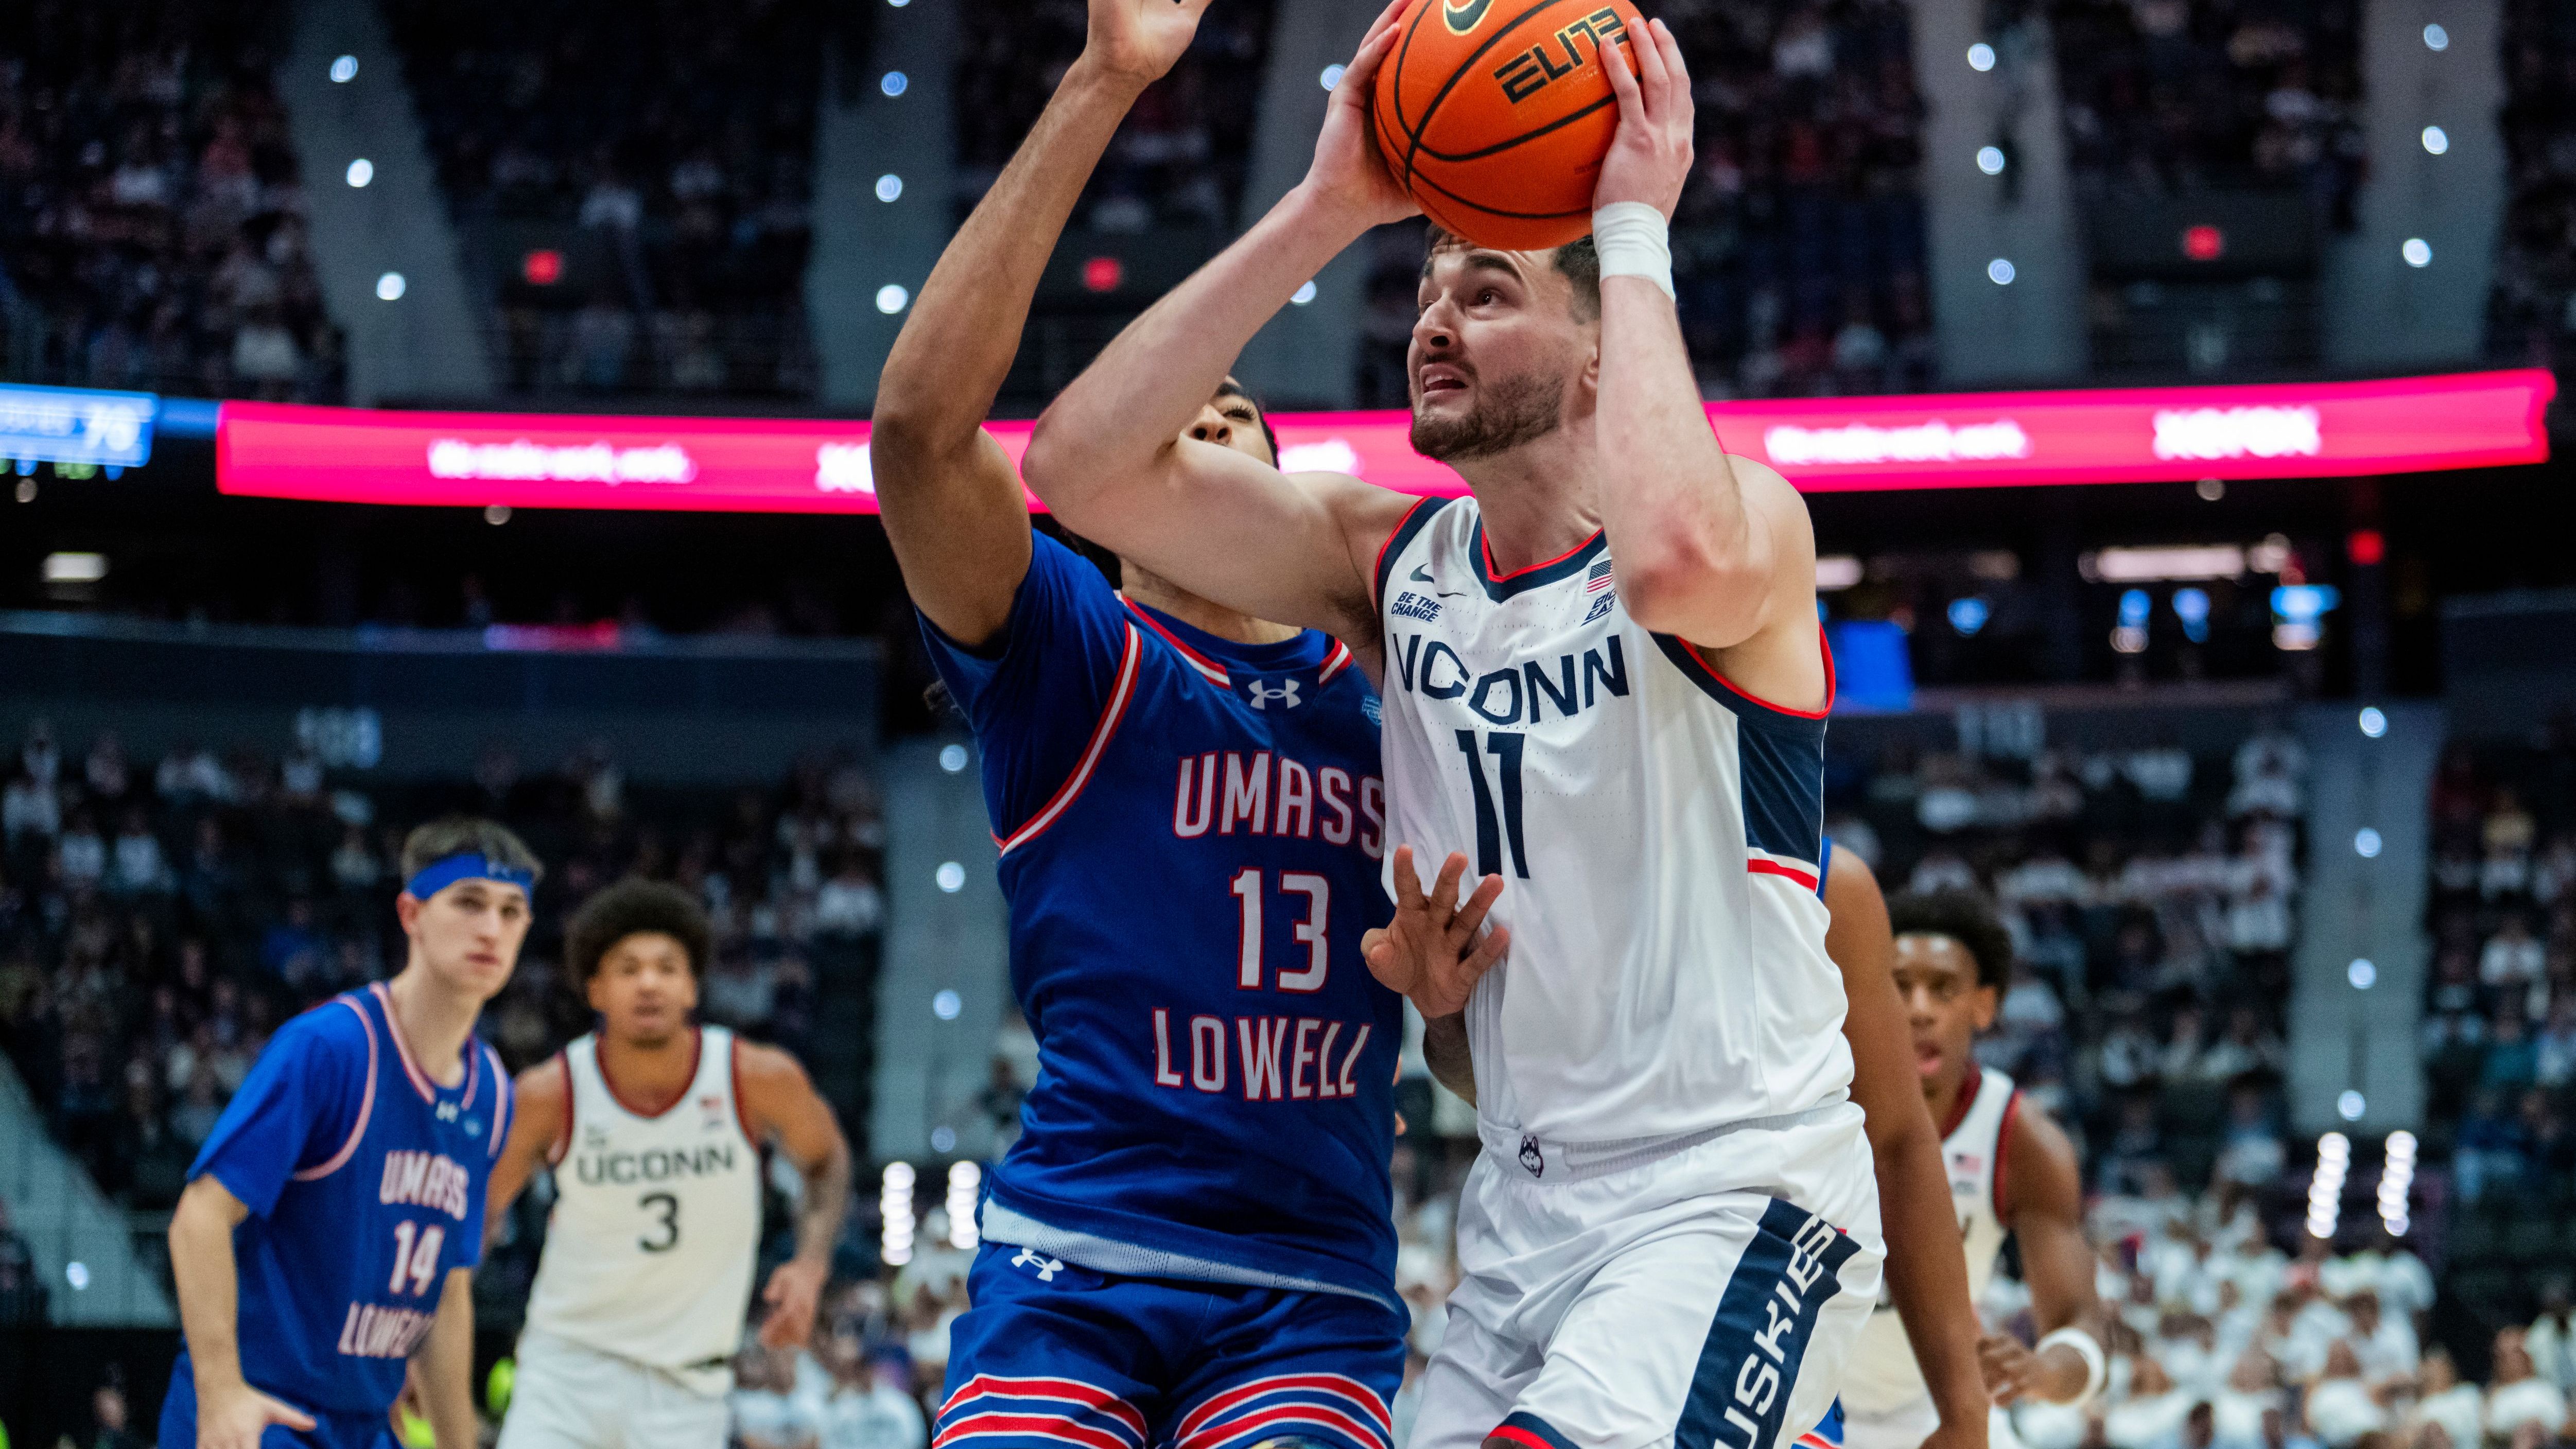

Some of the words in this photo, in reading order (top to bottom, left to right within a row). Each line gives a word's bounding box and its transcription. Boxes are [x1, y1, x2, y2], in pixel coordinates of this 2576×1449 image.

[1492, 5, 1630, 104] ELITE
[1391, 602, 1438, 622] CHANGE
[1397, 591, 1417, 603] BE
[1416, 596, 1442, 613] THE
[1585, 597, 1616, 621] EAS
[1393, 634, 1629, 725] UCONN
[1172, 750, 1386, 861] UMASS
[1455, 729, 1530, 879] 11
[1229, 866, 1330, 993] 13
[1152, 1006, 1373, 1102] LOWELL
[379, 1149, 468, 1220] UMASS
[576, 1143, 735, 1185] UCONN
[390, 1220, 444, 1296] 14
[637, 1191, 680, 1254] 3
[1713, 1214, 1837, 1449] USKIES
